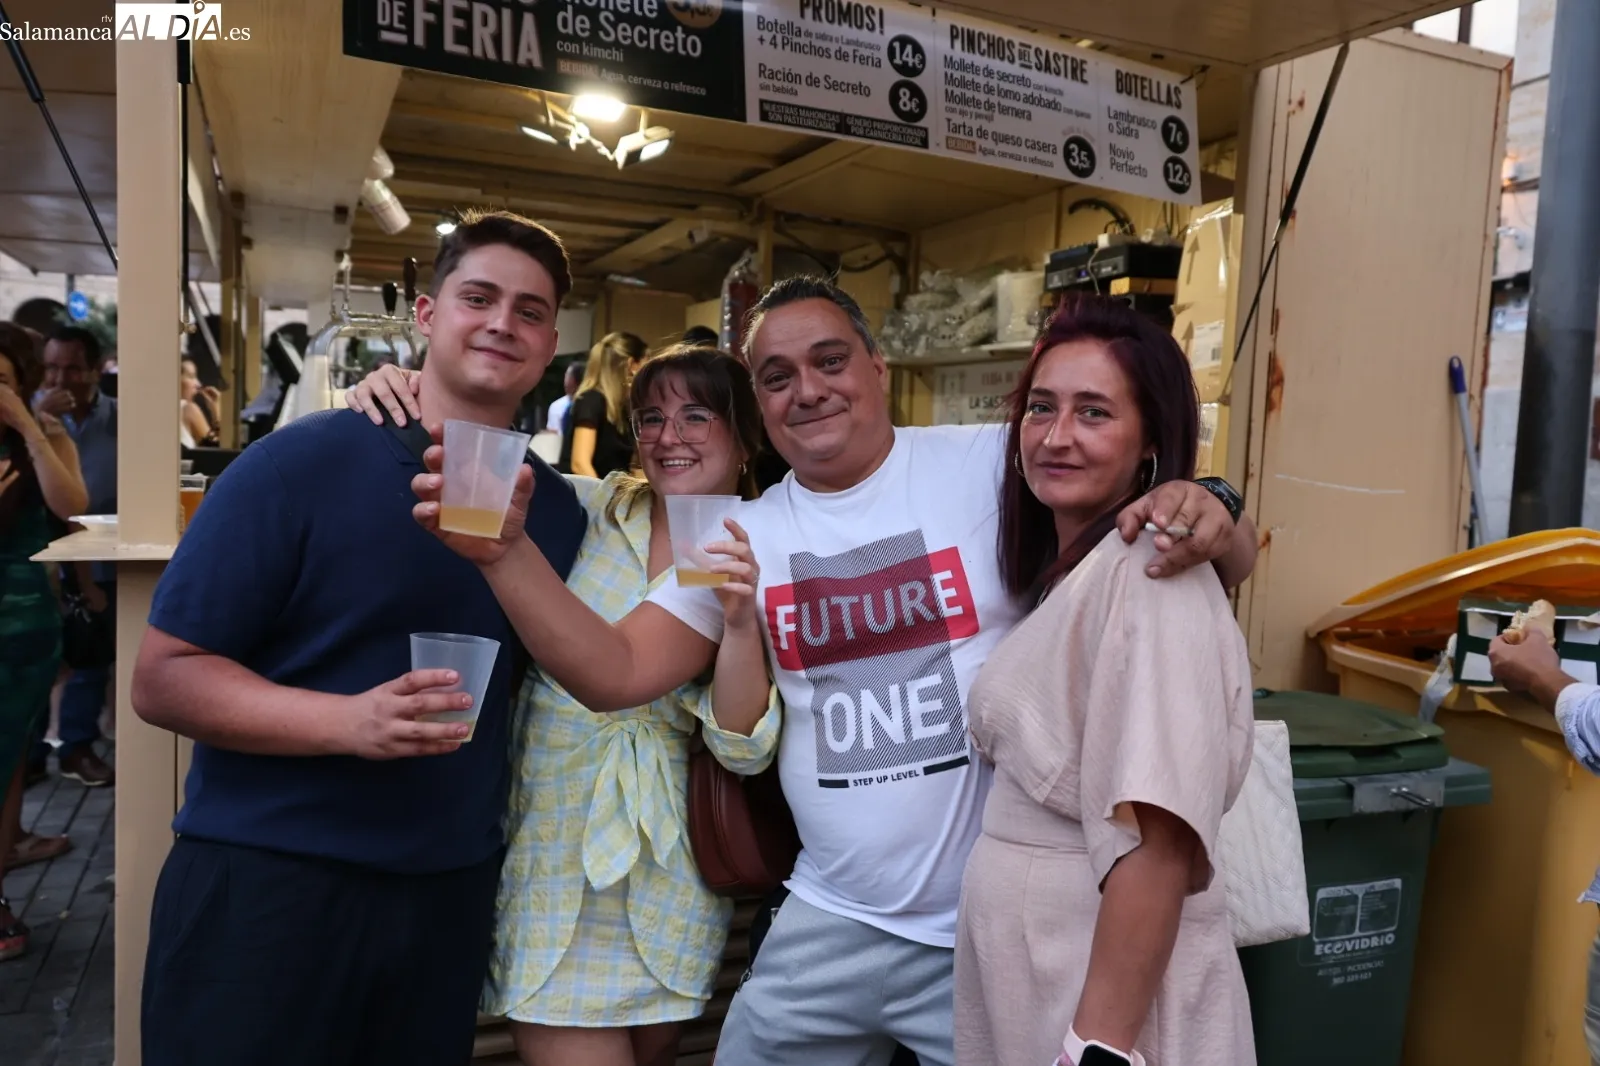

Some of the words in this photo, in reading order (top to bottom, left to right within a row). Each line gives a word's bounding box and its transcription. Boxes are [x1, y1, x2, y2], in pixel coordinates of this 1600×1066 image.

[377, 0, 407, 30] DE
[413, 0, 544, 69] FERIA
[556, 4, 591, 38] de
[598, 11, 702, 58] Secreto
[756, 15, 802, 36] Botella
[556, 40, 579, 53] con
[583, 42, 624, 62] kimchi
[769, 35, 778, 49] 4
[782, 38, 831, 60] Pinchos
[834, 46, 850, 62] de
[853, 51, 882, 69] Feria
[892, 41, 923, 69] 14€
[949, 24, 1016, 65] PINCHOS
[1034, 47, 1089, 84] SASTRE
[628, 74, 662, 89] cerveza
[758, 63, 802, 85] Ración
[805, 72, 821, 88] de
[824, 74, 871, 97] Secreto
[944, 54, 981, 76] Mollete
[982, 64, 995, 80] de
[996, 69, 1032, 89] secreto
[759, 82, 771, 92] sin
[772, 84, 798, 97] bebida
[898, 87, 919, 113] 8€
[944, 72, 982, 92] Mollete
[983, 81, 996, 96] de
[997, 83, 1021, 102] lomo
[1022, 91, 1062, 113] adobado
[1115, 68, 1182, 110] BOTELLAS
[944, 89, 982, 110] Mollete
[983, 97, 996, 113] de
[997, 102, 1032, 122] ternera
[1107, 105, 1157, 130] Lambrusco
[945, 118, 974, 138] Tarta
[976, 125, 989, 140] de
[991, 130, 1023, 148] queso
[1024, 135, 1058, 155] casera
[1108, 122, 1114, 134] o
[1116, 121, 1139, 140] Sidra
[1109, 142, 1135, 161] Novio
[1110, 157, 1148, 179] Perfecto
[776, 569, 963, 651] FUTURE
[822, 673, 951, 754] ONE
[852, 776, 874, 788] STEP
[876, 774, 889, 784] UP
[891, 769, 920, 782] LEVEL
[1314, 933, 1395, 956] ECOVIDRIO
